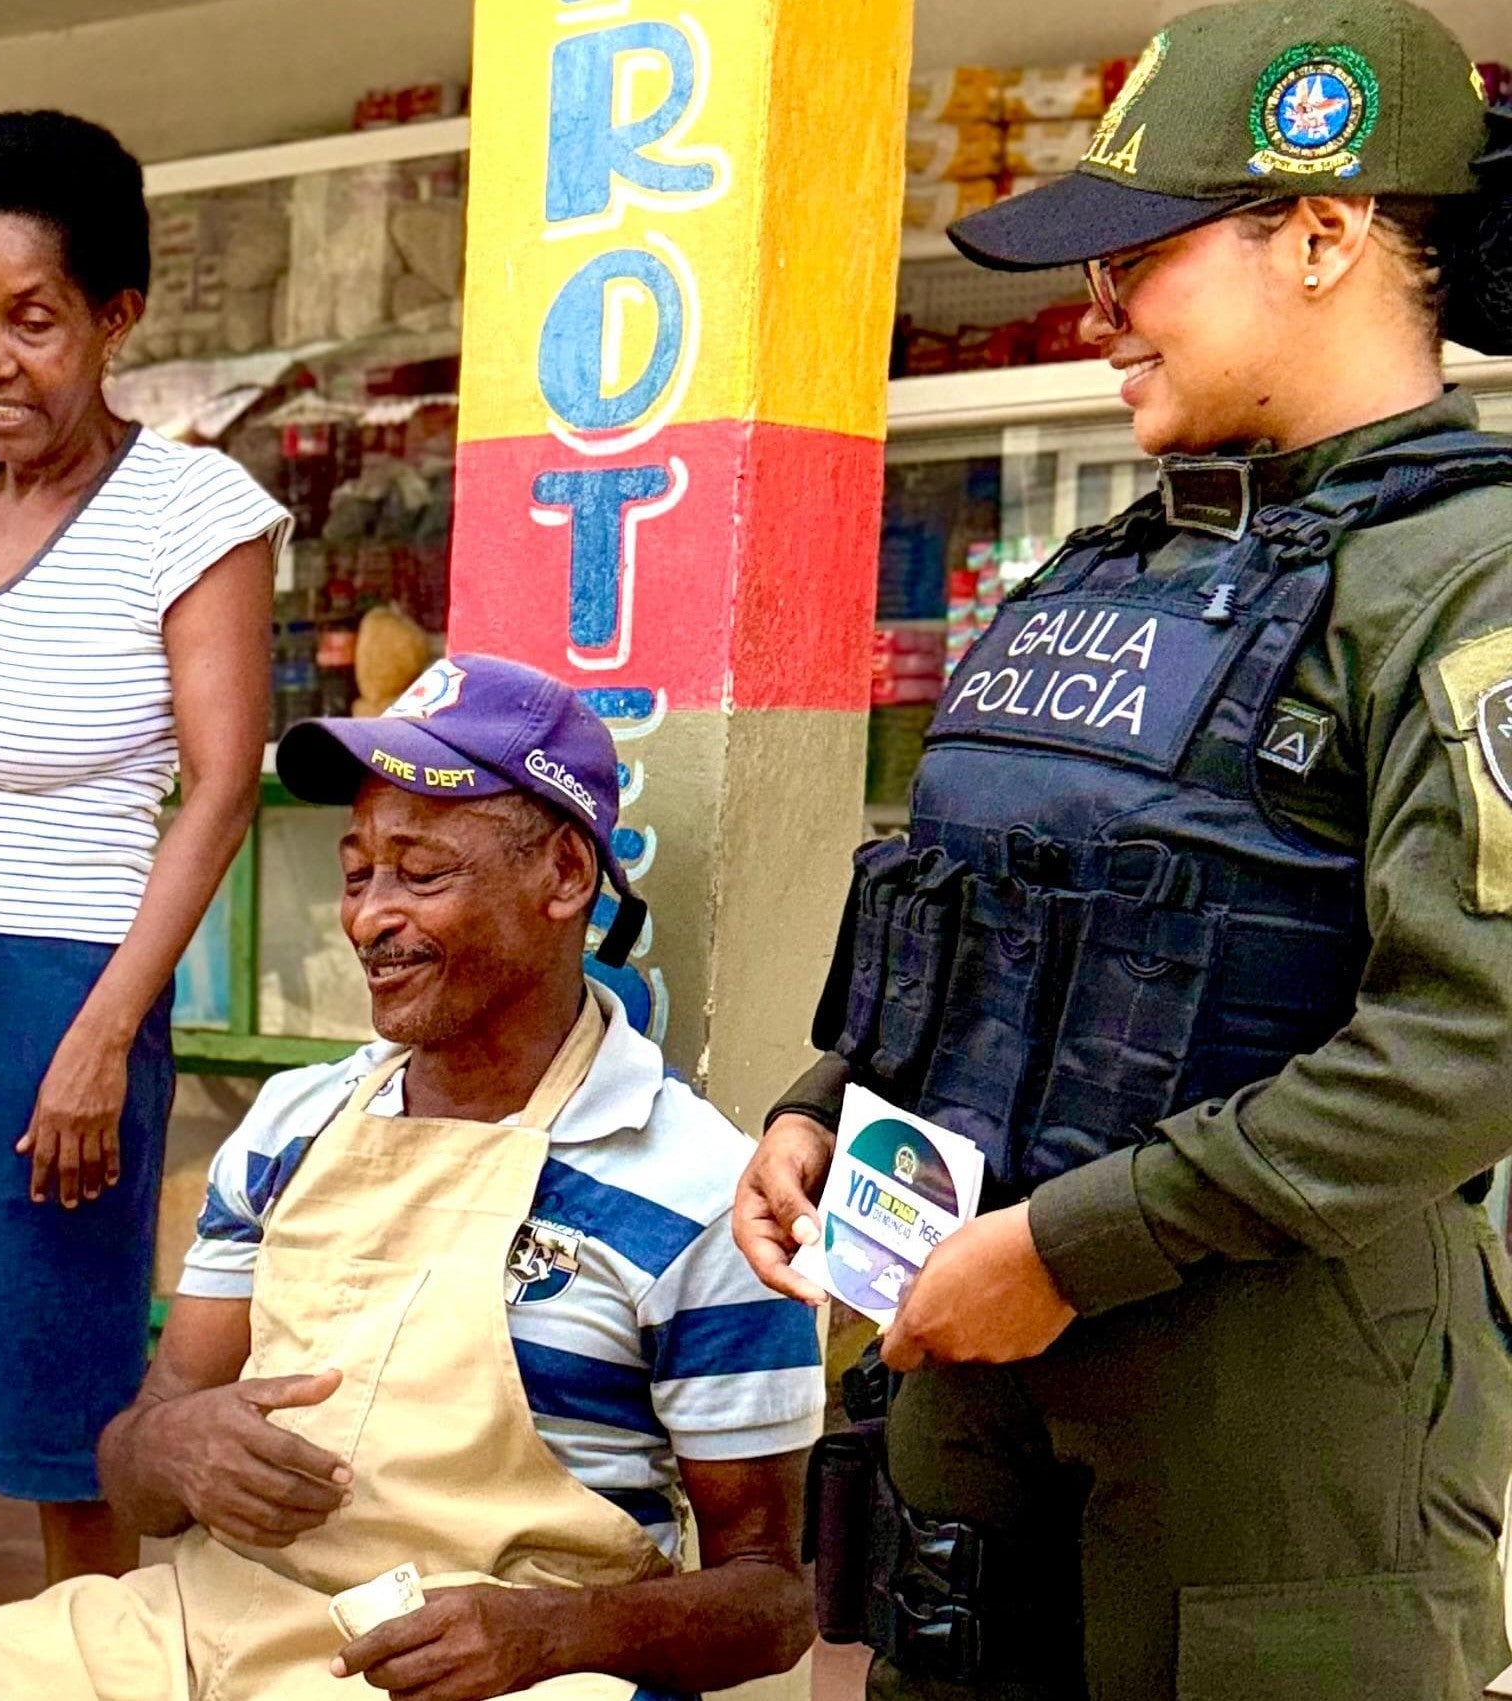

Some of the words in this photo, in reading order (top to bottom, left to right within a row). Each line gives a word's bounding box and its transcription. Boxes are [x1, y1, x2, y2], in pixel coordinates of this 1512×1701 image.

[1007, 608, 1158, 670] GAULA
[947, 667, 1148, 736] POLICÍA
[370, 748, 416, 782] FIRE
[424, 766, 476, 788] DEPT
[524, 748, 598, 821] Contecar
[846, 1169, 879, 1217] YO
[918, 1218, 942, 1248] 165
